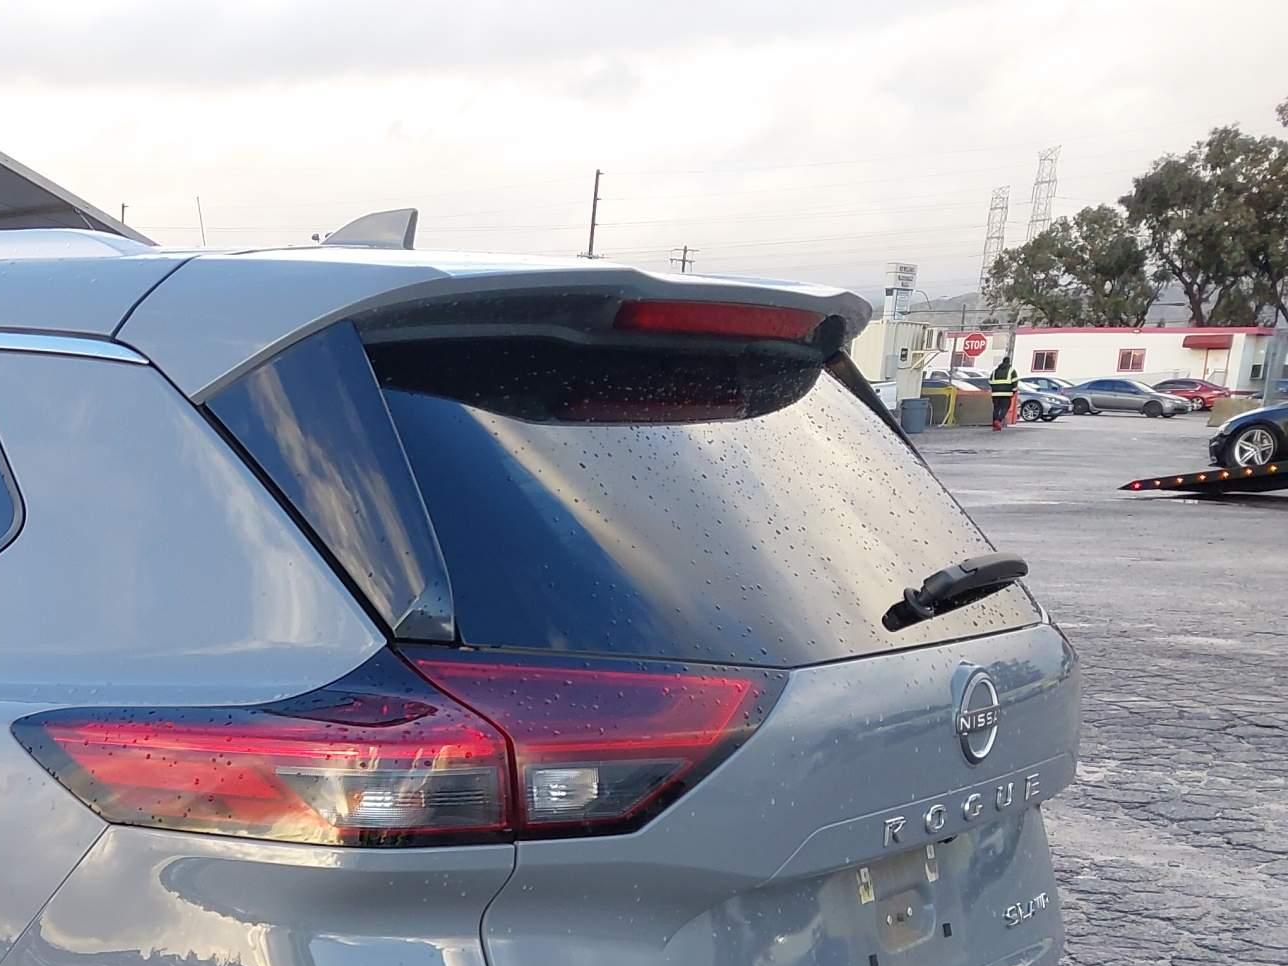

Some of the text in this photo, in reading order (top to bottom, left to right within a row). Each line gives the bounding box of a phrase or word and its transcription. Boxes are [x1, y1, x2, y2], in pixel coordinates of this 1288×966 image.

[964, 340, 986, 350] STOP
[960, 709, 999, 731] NISS
[884, 773, 1040, 847] ROGUE
